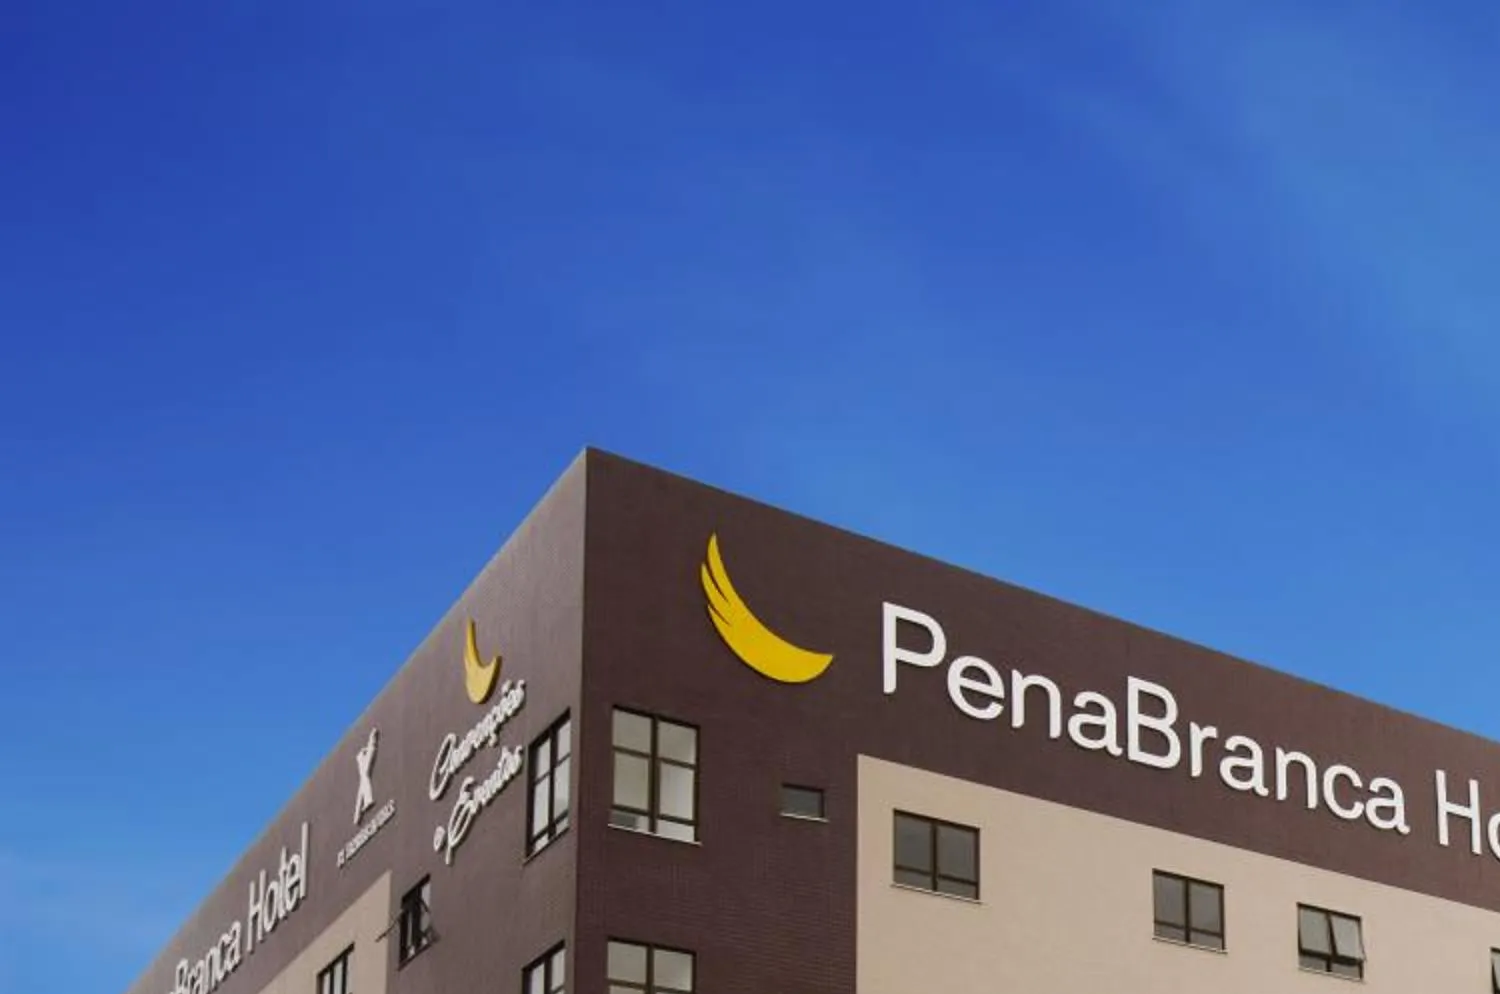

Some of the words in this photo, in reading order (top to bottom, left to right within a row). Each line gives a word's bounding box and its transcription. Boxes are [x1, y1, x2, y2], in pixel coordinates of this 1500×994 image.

[882, 601, 1411, 835] PenaBranca
[446, 744, 523, 866] Eventos
[247, 821, 309, 953] Hotel
